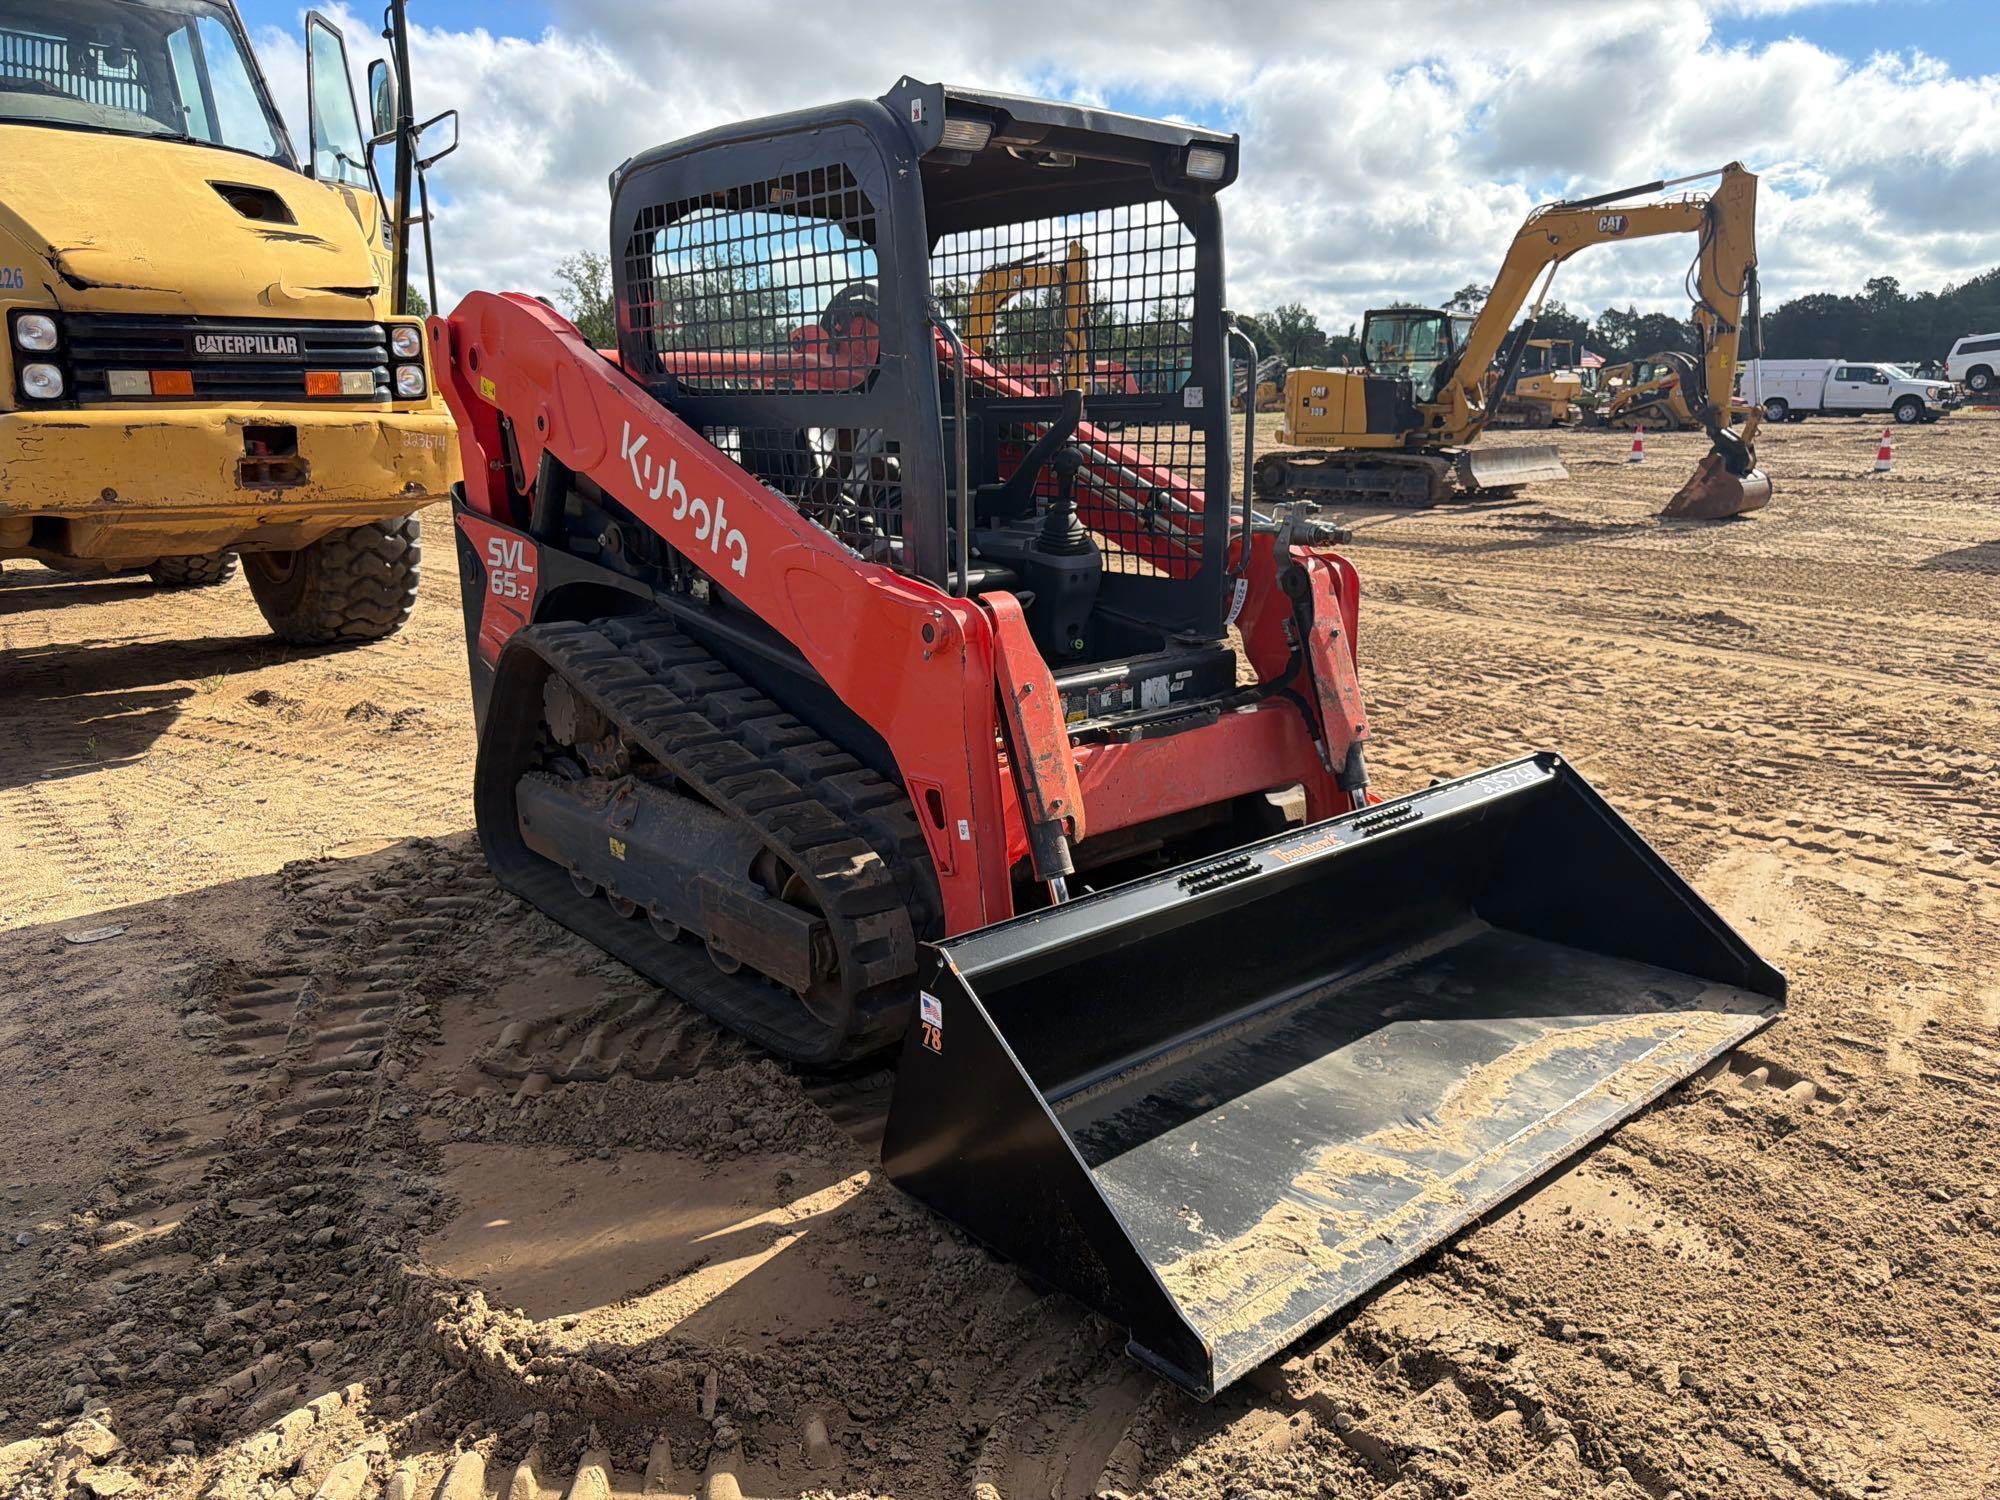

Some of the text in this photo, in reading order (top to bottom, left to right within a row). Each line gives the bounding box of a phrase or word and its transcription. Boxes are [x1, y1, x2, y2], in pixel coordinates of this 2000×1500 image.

[1599, 215, 1623, 232] CAT
[194, 335, 298, 354] CATERPILLAR
[1311, 386, 1326, 398] CAT
[402, 431, 446, 451] 223674
[621, 420, 748, 578] Kubota
[487, 537, 534, 573] SVL
[491, 569, 530, 601] 65-2
[1267, 831, 1339, 863] Tomahawk
[921, 1021, 942, 1051] 78
